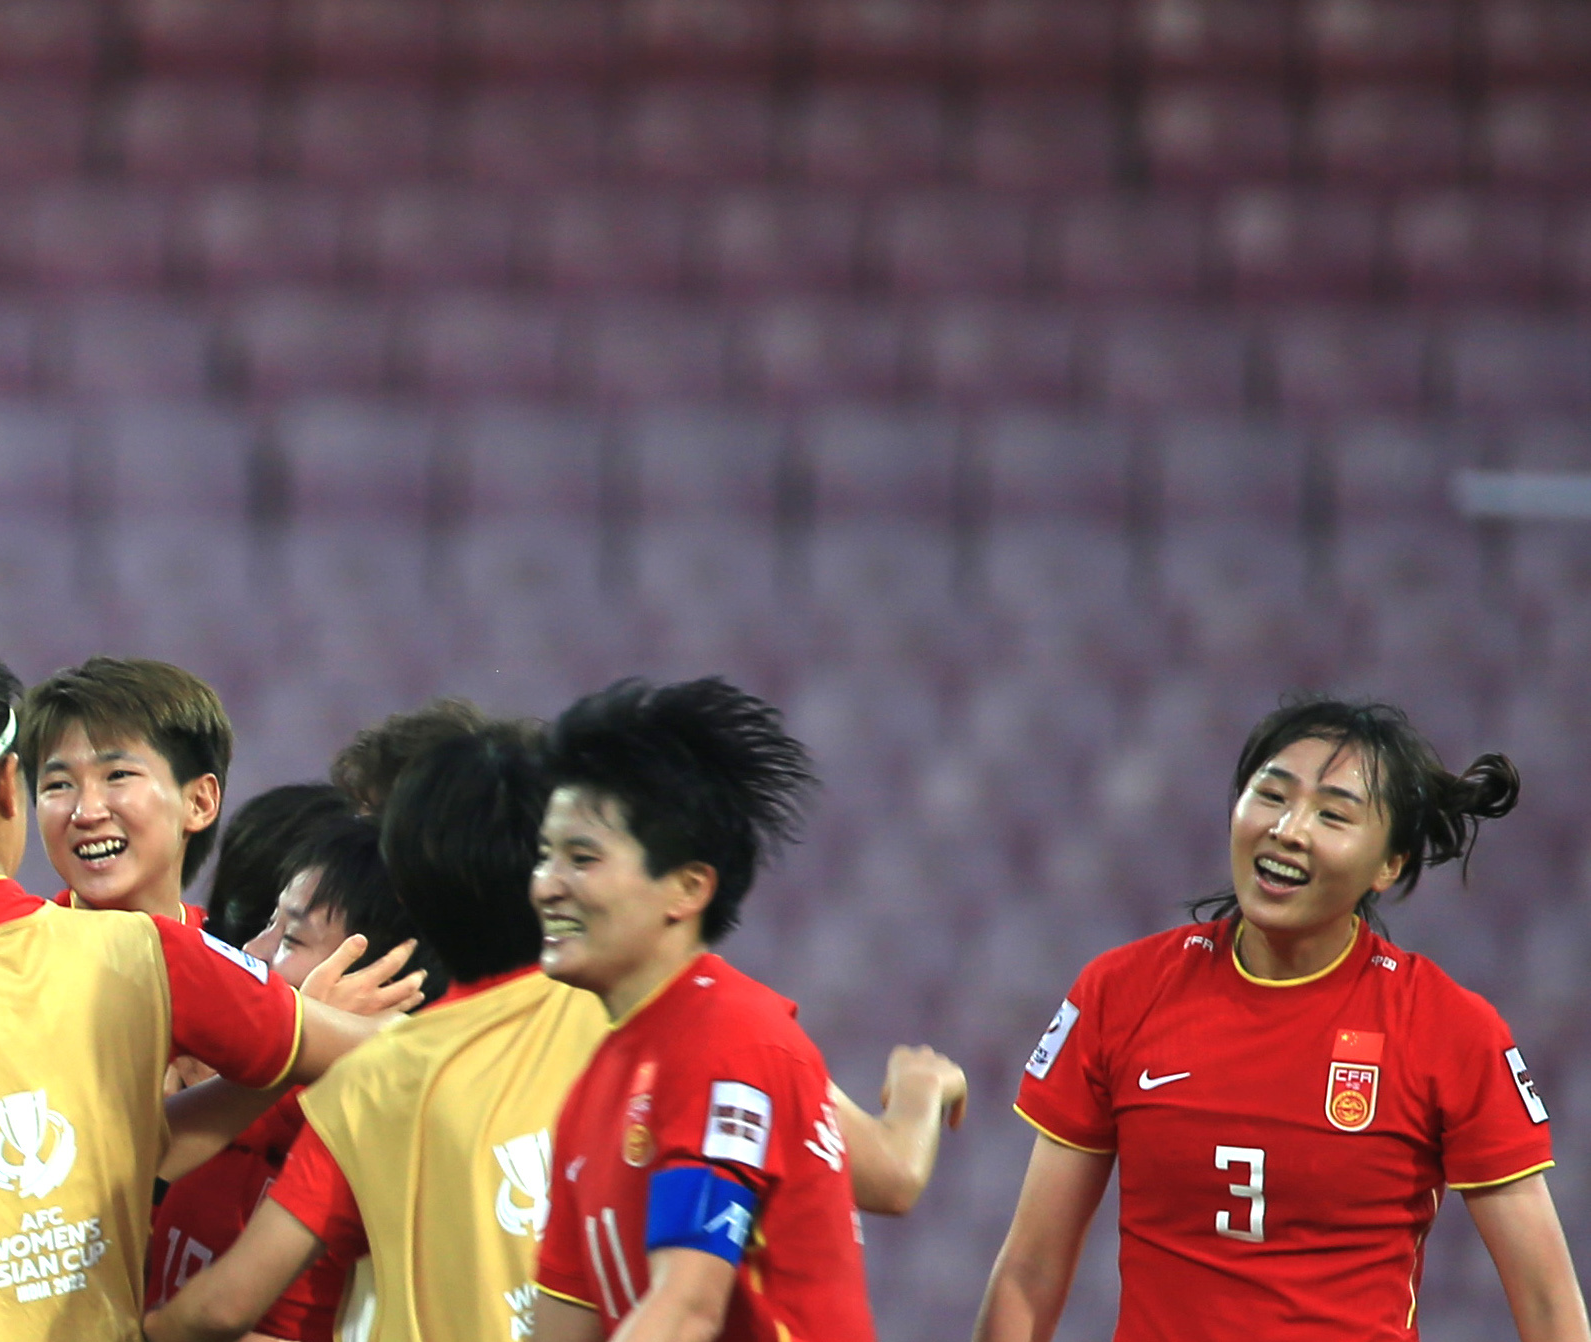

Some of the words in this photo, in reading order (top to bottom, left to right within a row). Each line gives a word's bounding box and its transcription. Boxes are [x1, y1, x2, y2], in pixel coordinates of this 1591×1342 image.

[1335, 1068, 1373, 1084] CFA
[1215, 1145, 1265, 1243] 3
[21, 1206, 64, 1232] AFC
[62, 1241, 106, 1272] CUP
[585, 1207, 640, 1319] 11
